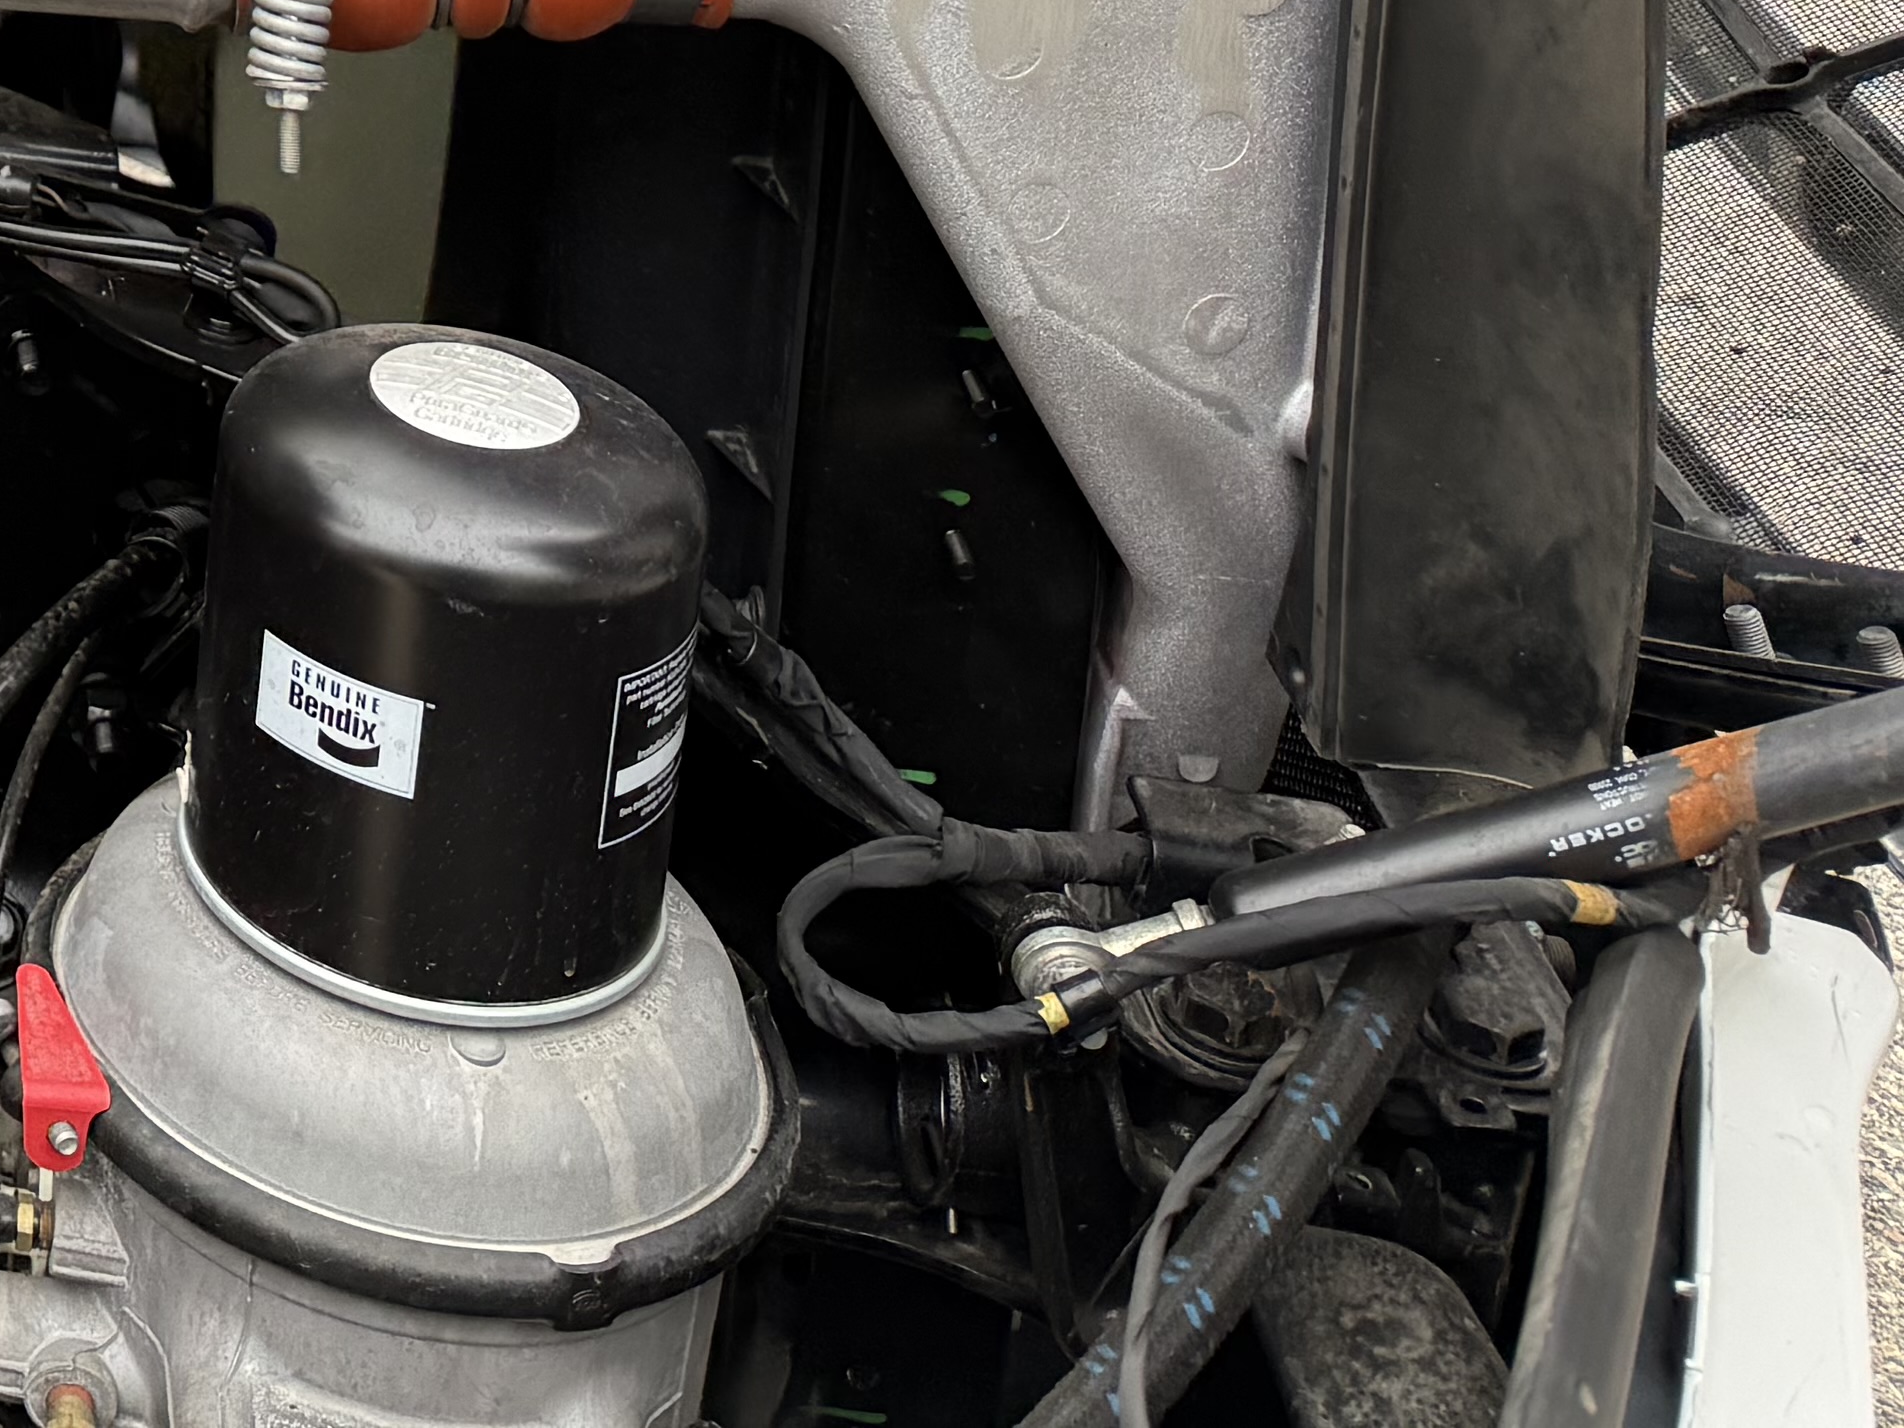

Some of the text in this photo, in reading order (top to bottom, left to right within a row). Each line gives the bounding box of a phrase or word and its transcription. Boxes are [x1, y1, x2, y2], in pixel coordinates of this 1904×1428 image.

[288, 679, 377, 744] Bendix
[291, 659, 381, 715] GENUINE
[318, 1009, 433, 1055] SERVICING
